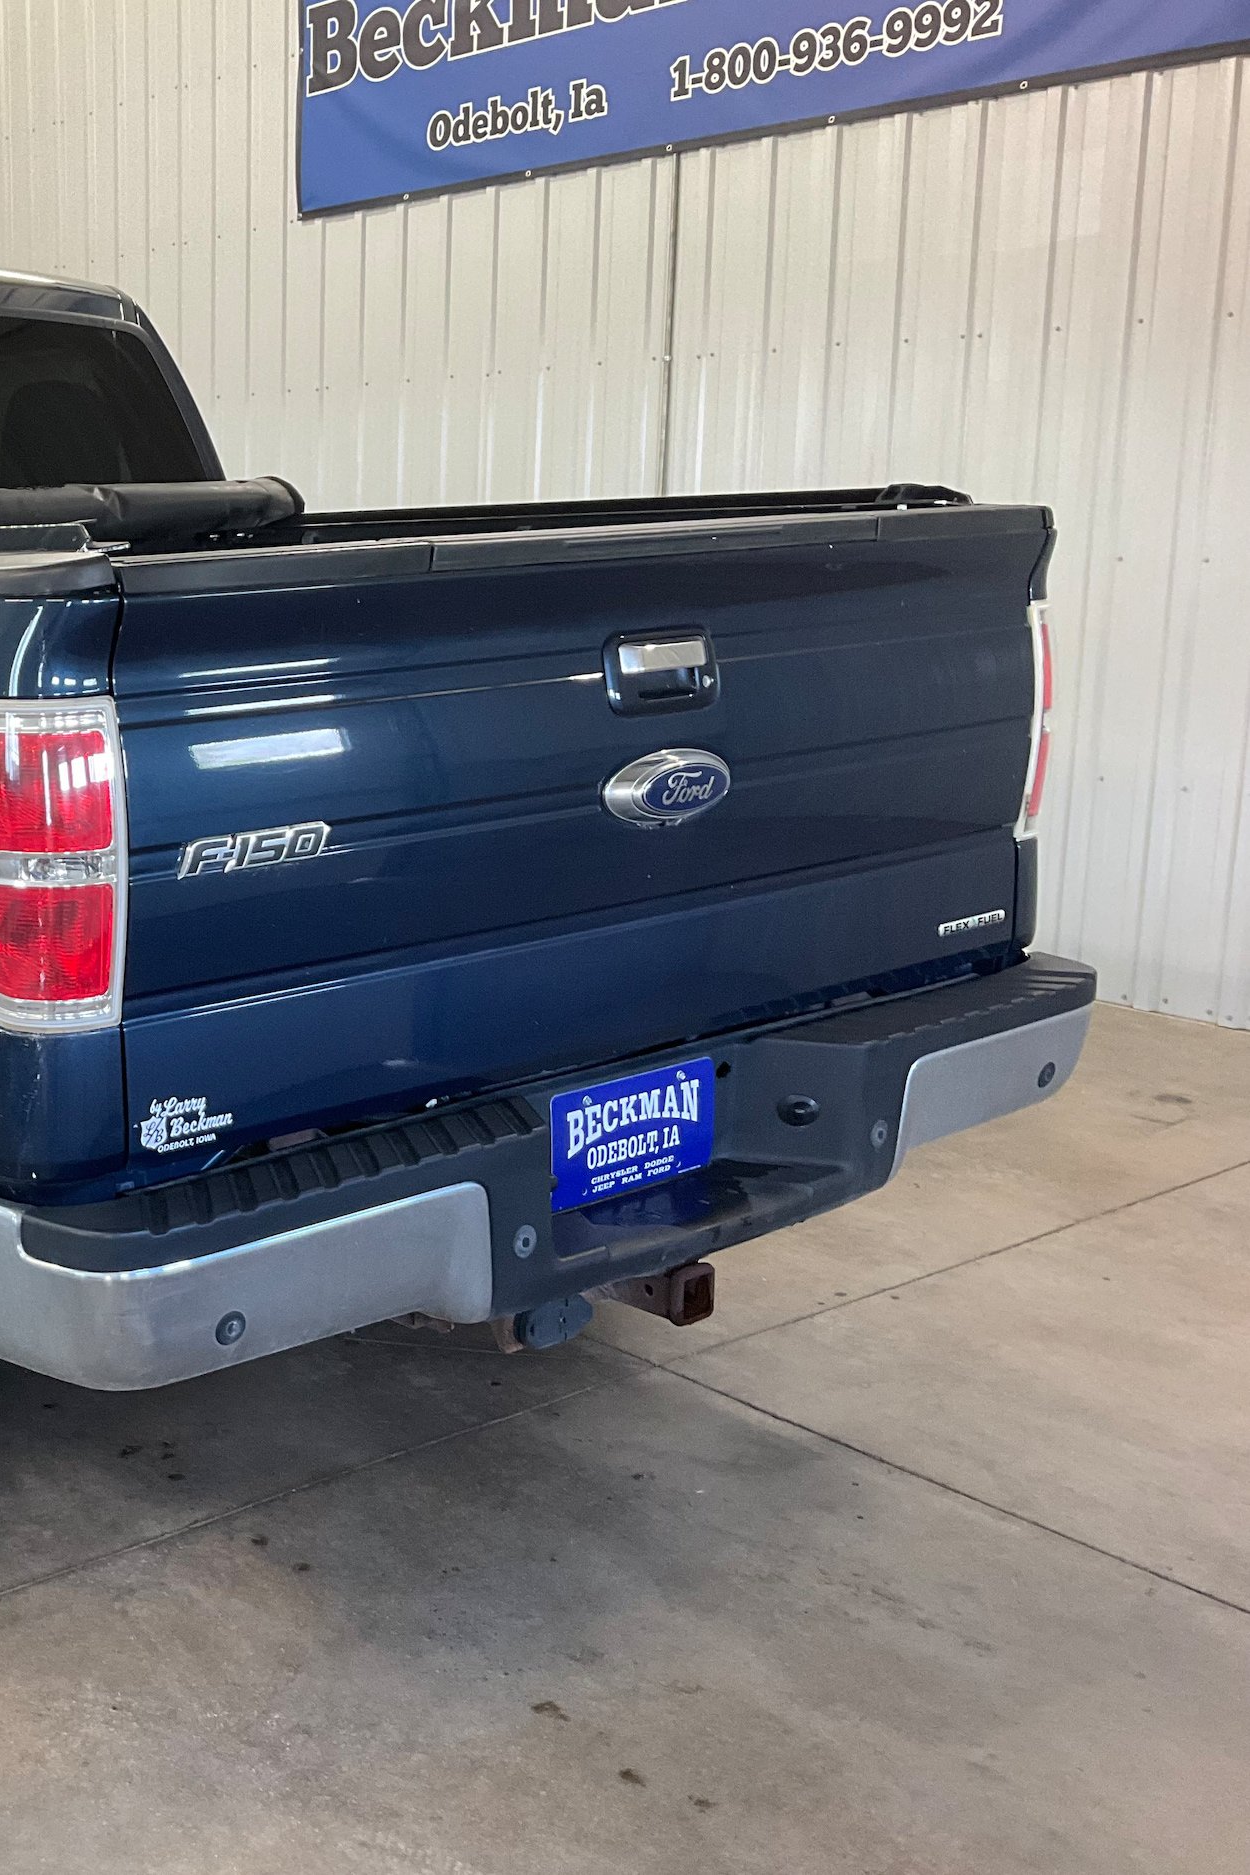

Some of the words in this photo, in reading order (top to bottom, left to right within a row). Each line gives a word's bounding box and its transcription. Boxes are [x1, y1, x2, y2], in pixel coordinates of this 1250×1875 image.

[305, 0, 688, 97] Beck
[670, 0, 1004, 101] 1-800-936-9992
[427, 86, 565, 151] Odebolt,
[568, 78, 608, 123] Ia
[662, 771, 715, 806] Ford
[943, 920, 970, 935] FLEX
[977, 912, 1004, 926] FUEL
[160, 1096, 207, 1117] Larry
[566, 1078, 700, 1160] BECKMAN
[169, 1111, 234, 1138] Beckman
[195, 1132, 217, 1145] IOWA
[586, 1130, 659, 1171] ODEBOLT,
[662, 1124, 681, 1149] IA
[591, 1165, 639, 1185] CHRYSLER
[644, 1154, 675, 1171] DODGE
[592, 1181, 616, 1194] JEEP
[621, 1173, 643, 1186] RAM
[647, 1164, 671, 1178] FORD
